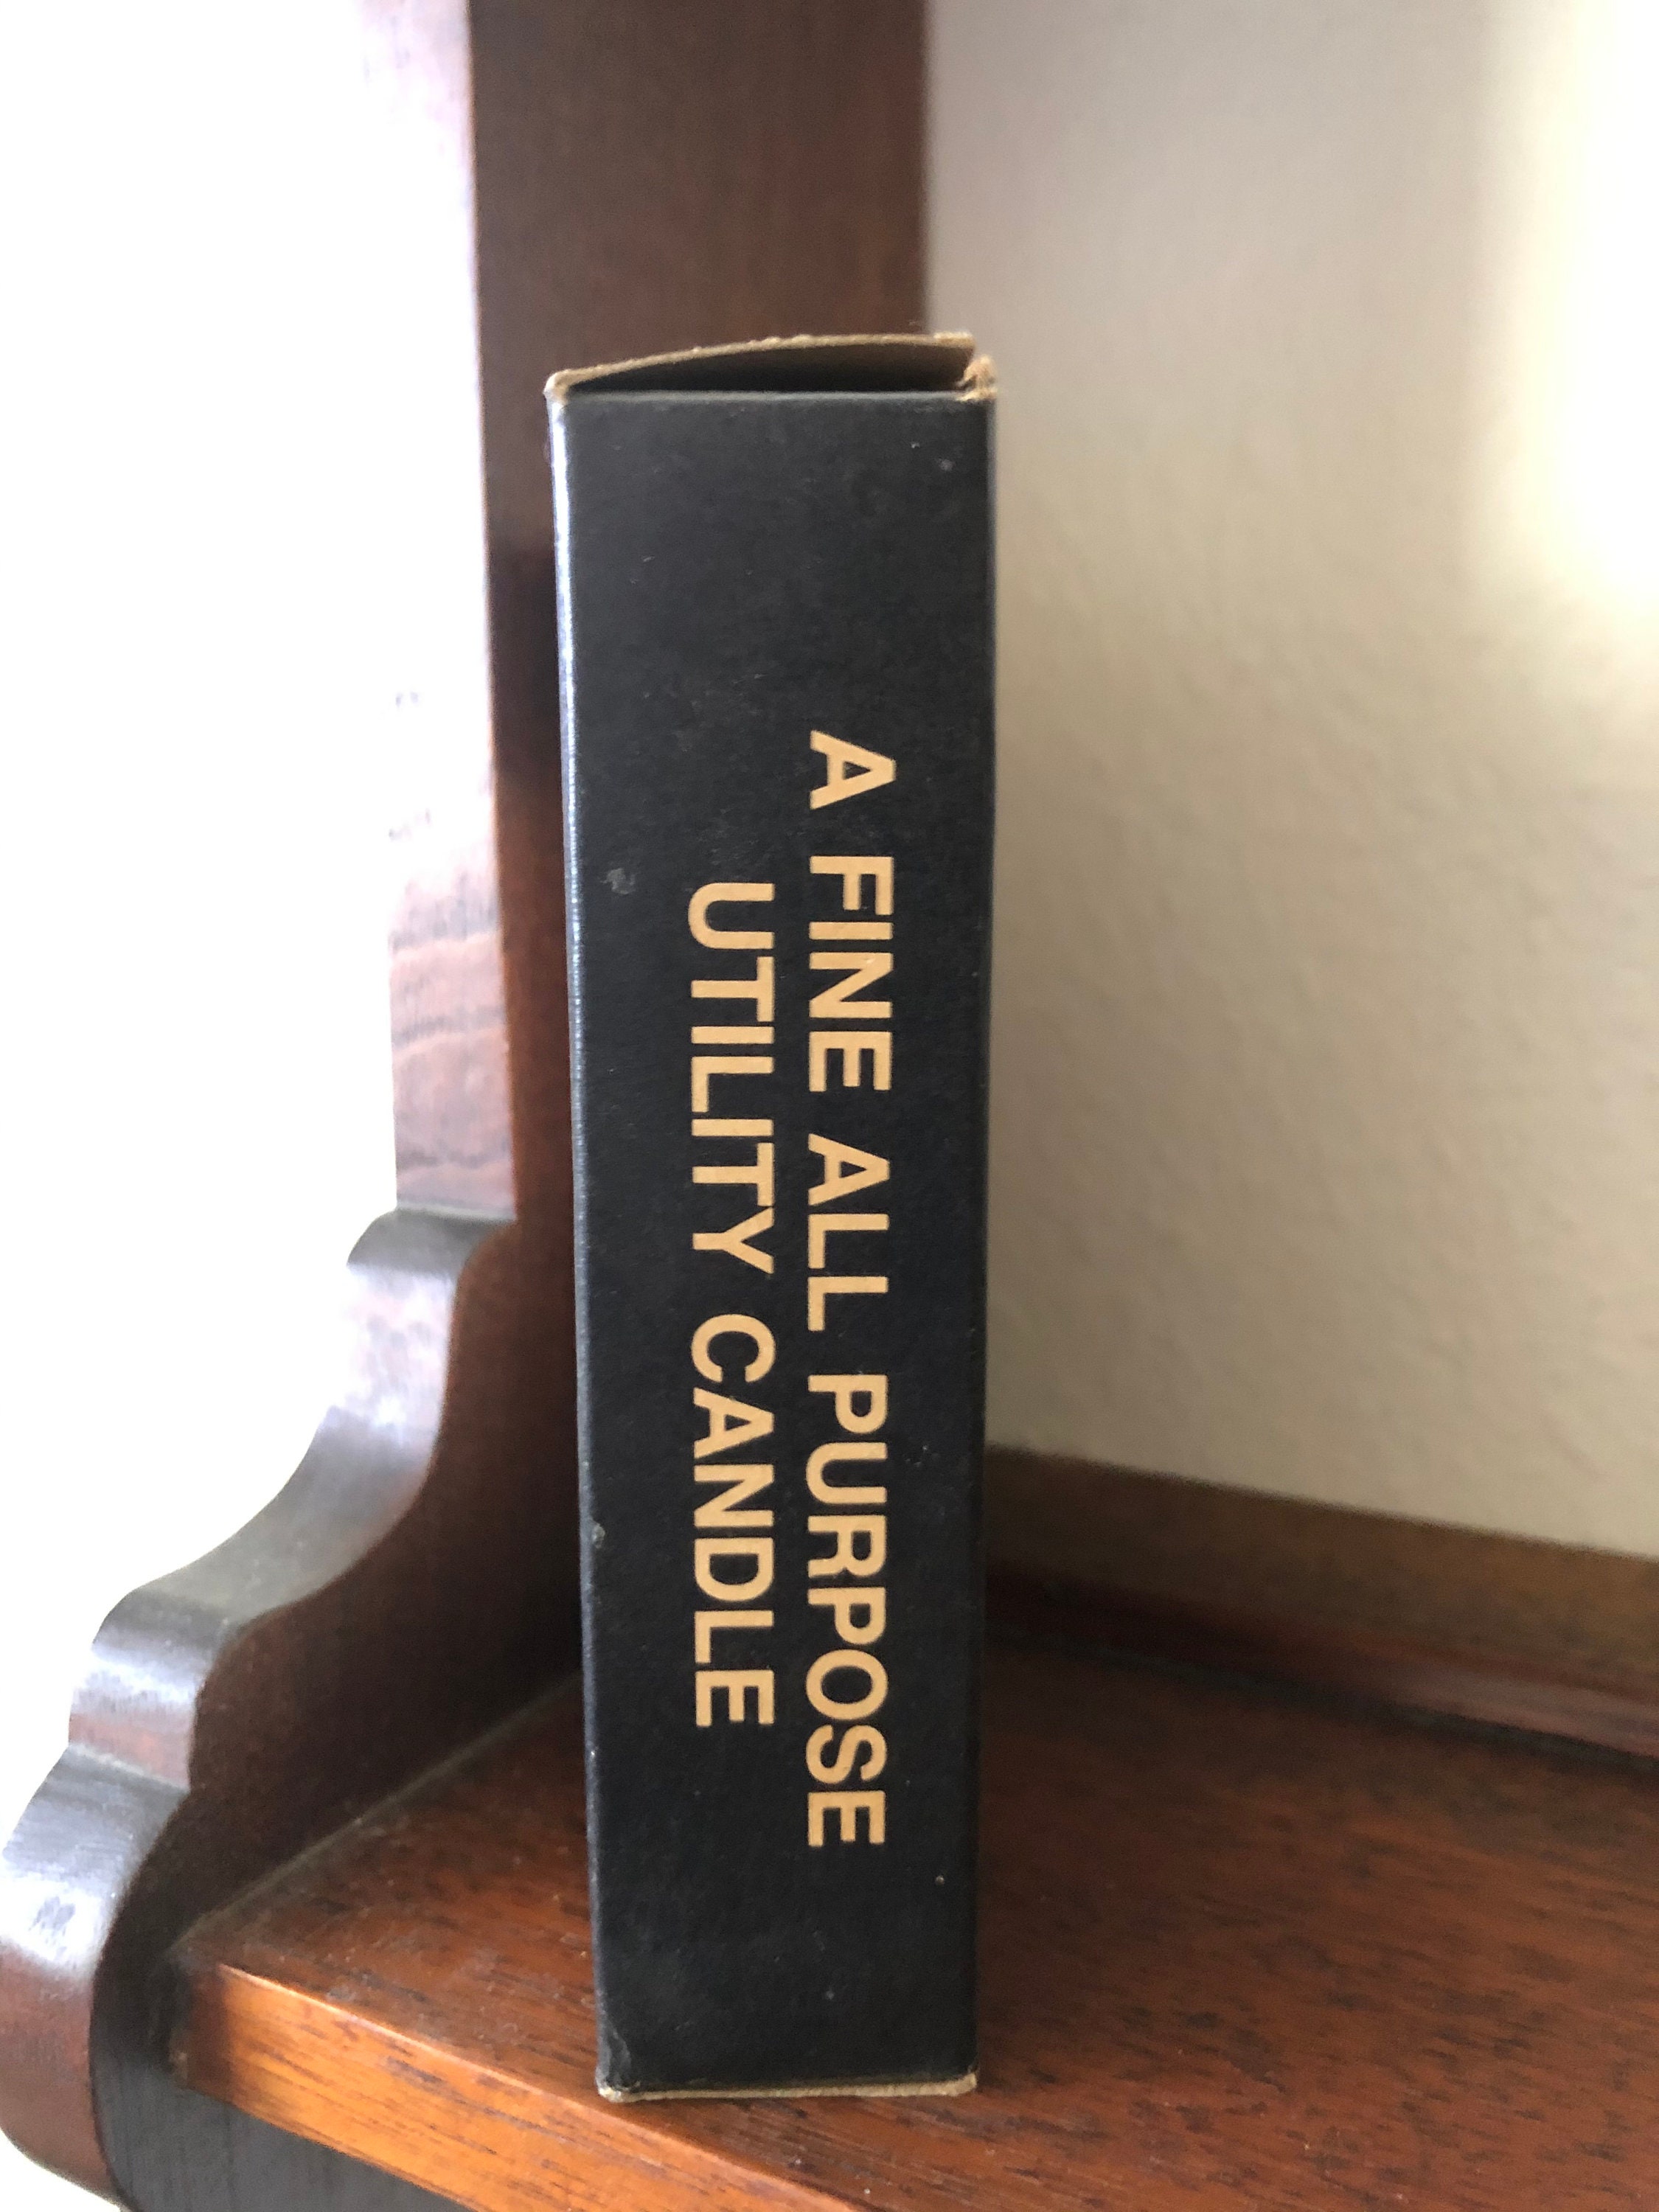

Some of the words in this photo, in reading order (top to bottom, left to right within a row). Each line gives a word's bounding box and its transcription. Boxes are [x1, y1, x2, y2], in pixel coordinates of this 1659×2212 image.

[810, 730, 896, 810] A
[688, 882, 775, 1274] UTILITY
[809, 855, 894, 1092] FINE
[807, 1133, 890, 1332] ALL
[691, 1314, 776, 1727] CANDLE
[805, 1374, 888, 1847] PURPOSE
